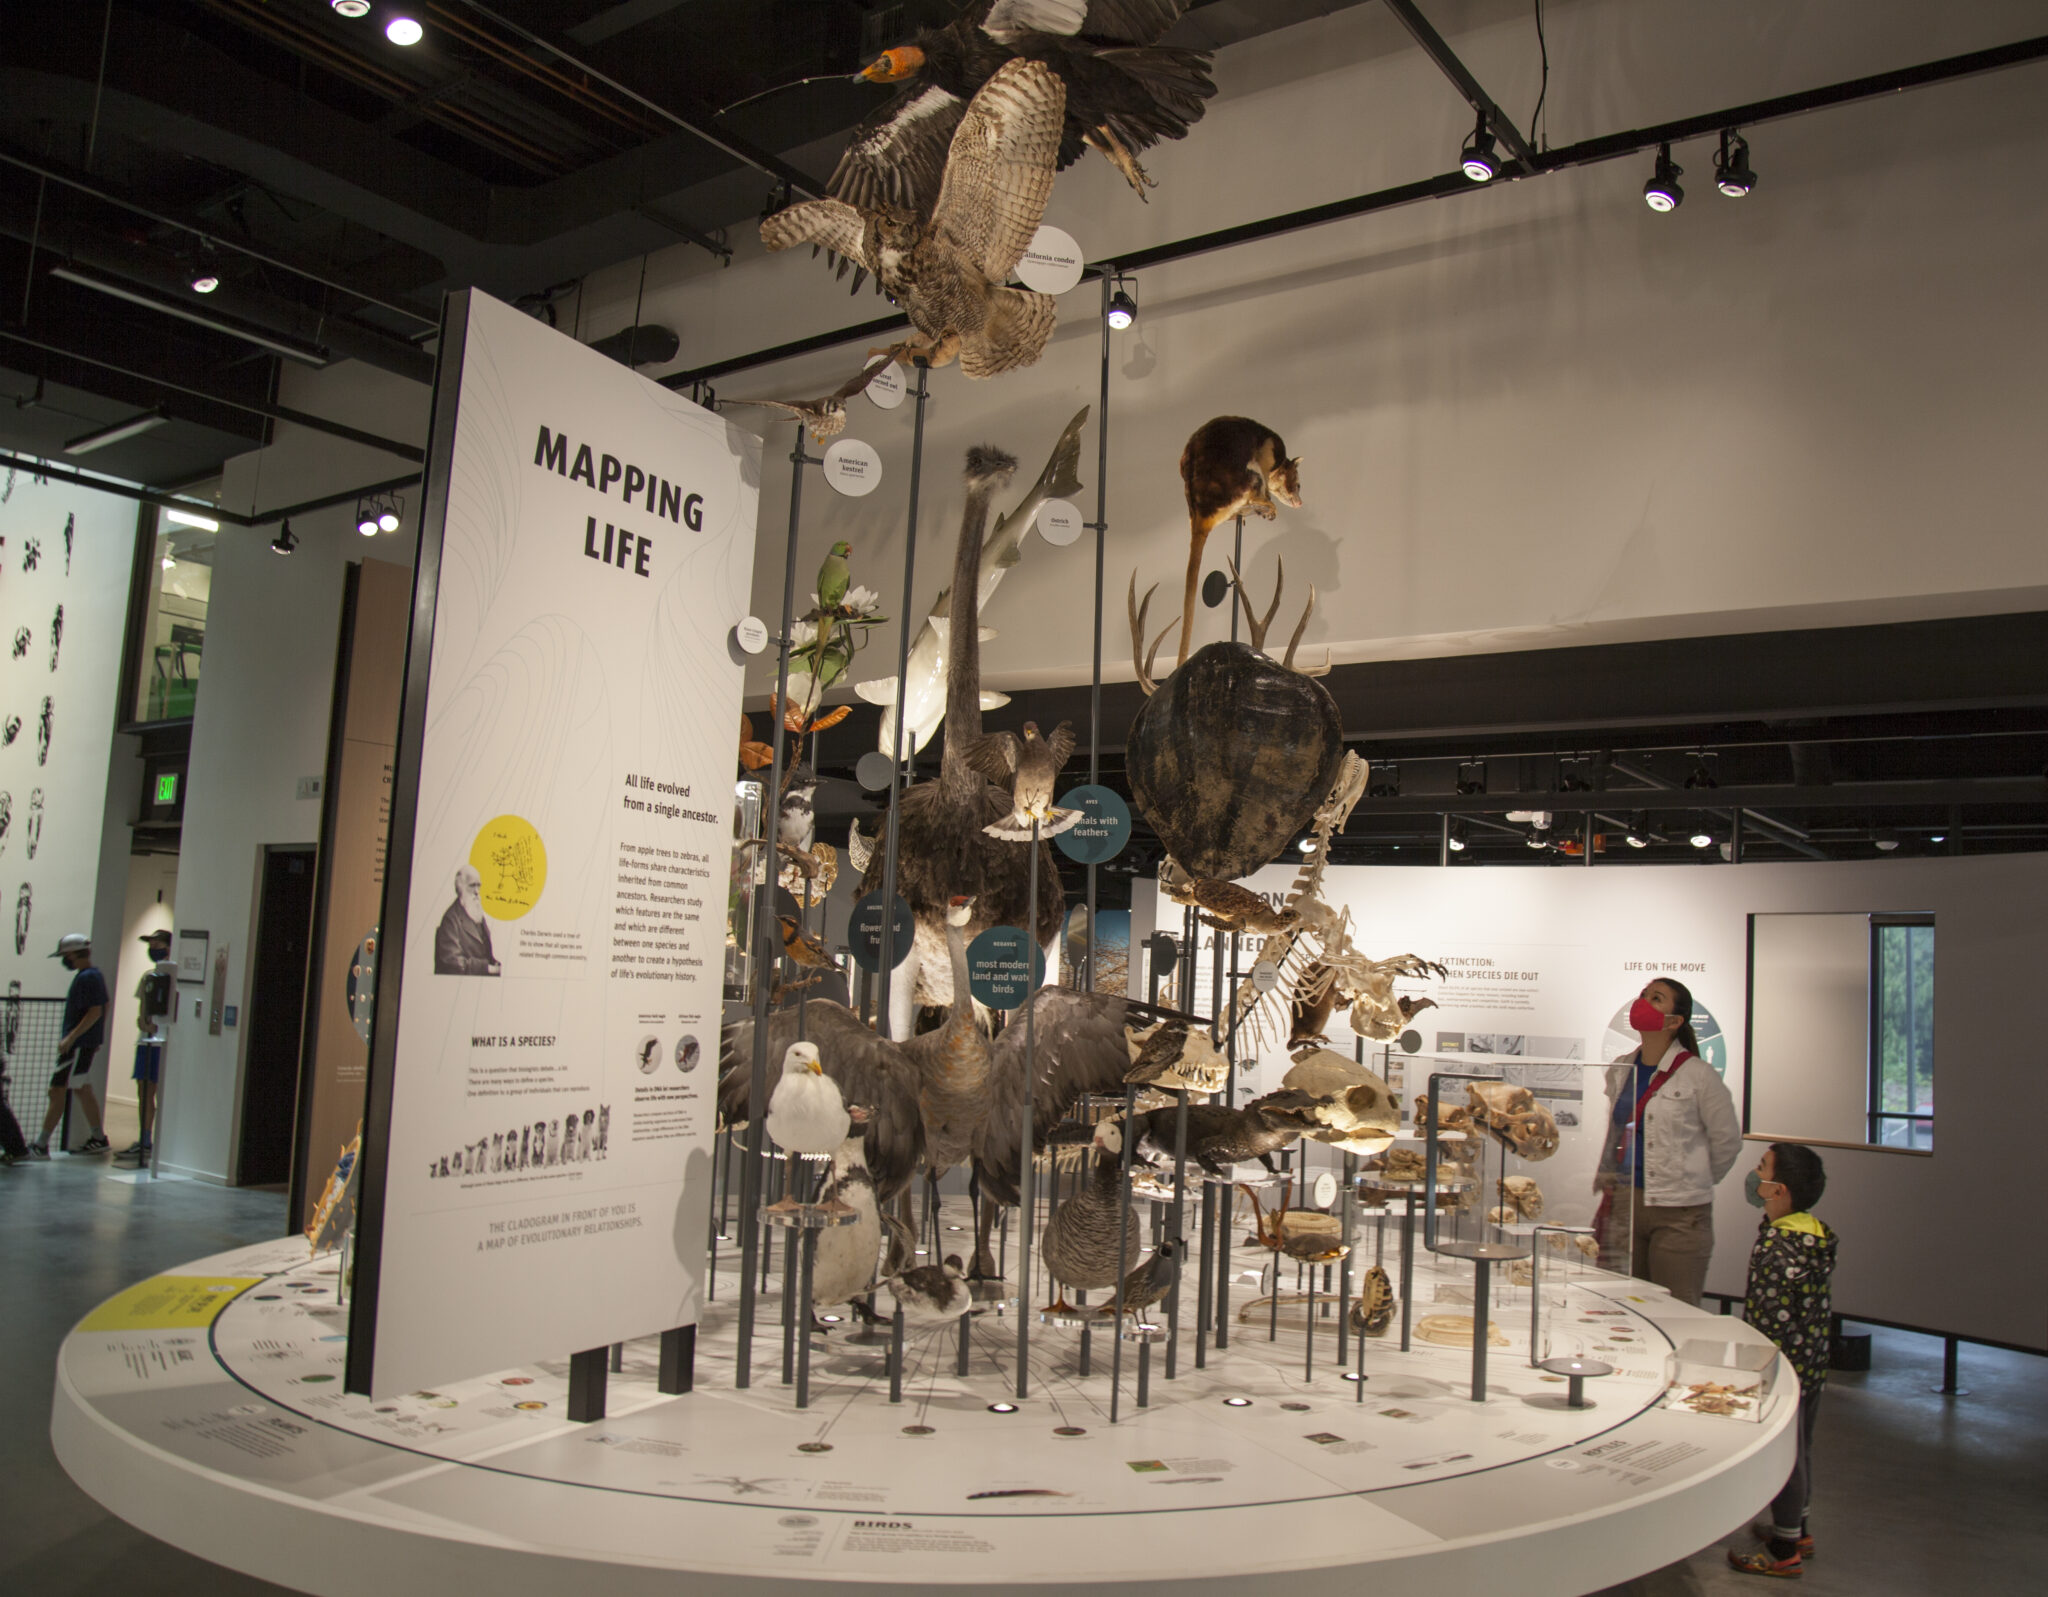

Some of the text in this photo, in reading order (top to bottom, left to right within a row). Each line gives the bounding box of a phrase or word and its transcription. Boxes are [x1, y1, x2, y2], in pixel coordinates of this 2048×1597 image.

[1024, 252, 1052, 261] alifornia
[1054, 256, 1075, 264] condor
[838, 457, 868, 467] American
[842, 464, 864, 474] kestrel
[534, 424, 704, 532] MAPPING
[584, 516, 652, 578] LIFE
[158, 776, 175, 800] EXIT
[625, 774, 690, 798] All life evolved
[624, 795, 718, 824] from a single ancestor.
[1100, 817, 1118, 825] with
[1074, 828, 1108, 836] feathers
[620, 842, 636, 852] From
[638, 846, 654, 856] apple
[656, 848, 671, 858] trees
[673, 850, 679, 858] to
[680, 851, 701, 862] zebras,
[619, 857, 710, 878] life-forms share characteristics
[618, 874, 688, 890] inherited from common
[616, 890, 703, 908] ancestors. Researchers study
[615, 906, 634, 915] which
[636, 907, 660, 918] features
[673, 910, 683, 920] the
[684, 913, 700, 921] same
[614, 922, 685, 935] and which are different
[861, 923, 882, 932] flower
[613, 937, 689, 951] between one species and
[612, 953, 636, 963] another
[638, 955, 645, 963] to
[646, 955, 665, 964] create
[672, 956, 703, 967] hypothesis
[1440, 957, 1495, 966] EXTINCTION:
[1624, 962, 1706, 972] LIFE ON THE MOVE
[611, 969, 696, 983] of life's evolutionary history.
[972, 971, 990, 980] land
[993, 972, 1008, 980] and
[1448, 970, 1539, 981] HEN SPECIES DIE OUT
[992, 984, 1014, 993] birds
[472, 1035, 556, 1047] WHAT IS A SPECIES?
[490, 1203, 636, 1234] THE CLADOGRAM IN FRONT OF YOU IS
[477, 1217, 642, 1251] A MAP OF EVOLUTIONARY RELATIONSHIPS.
[854, 1521, 913, 1529] BIRDS
